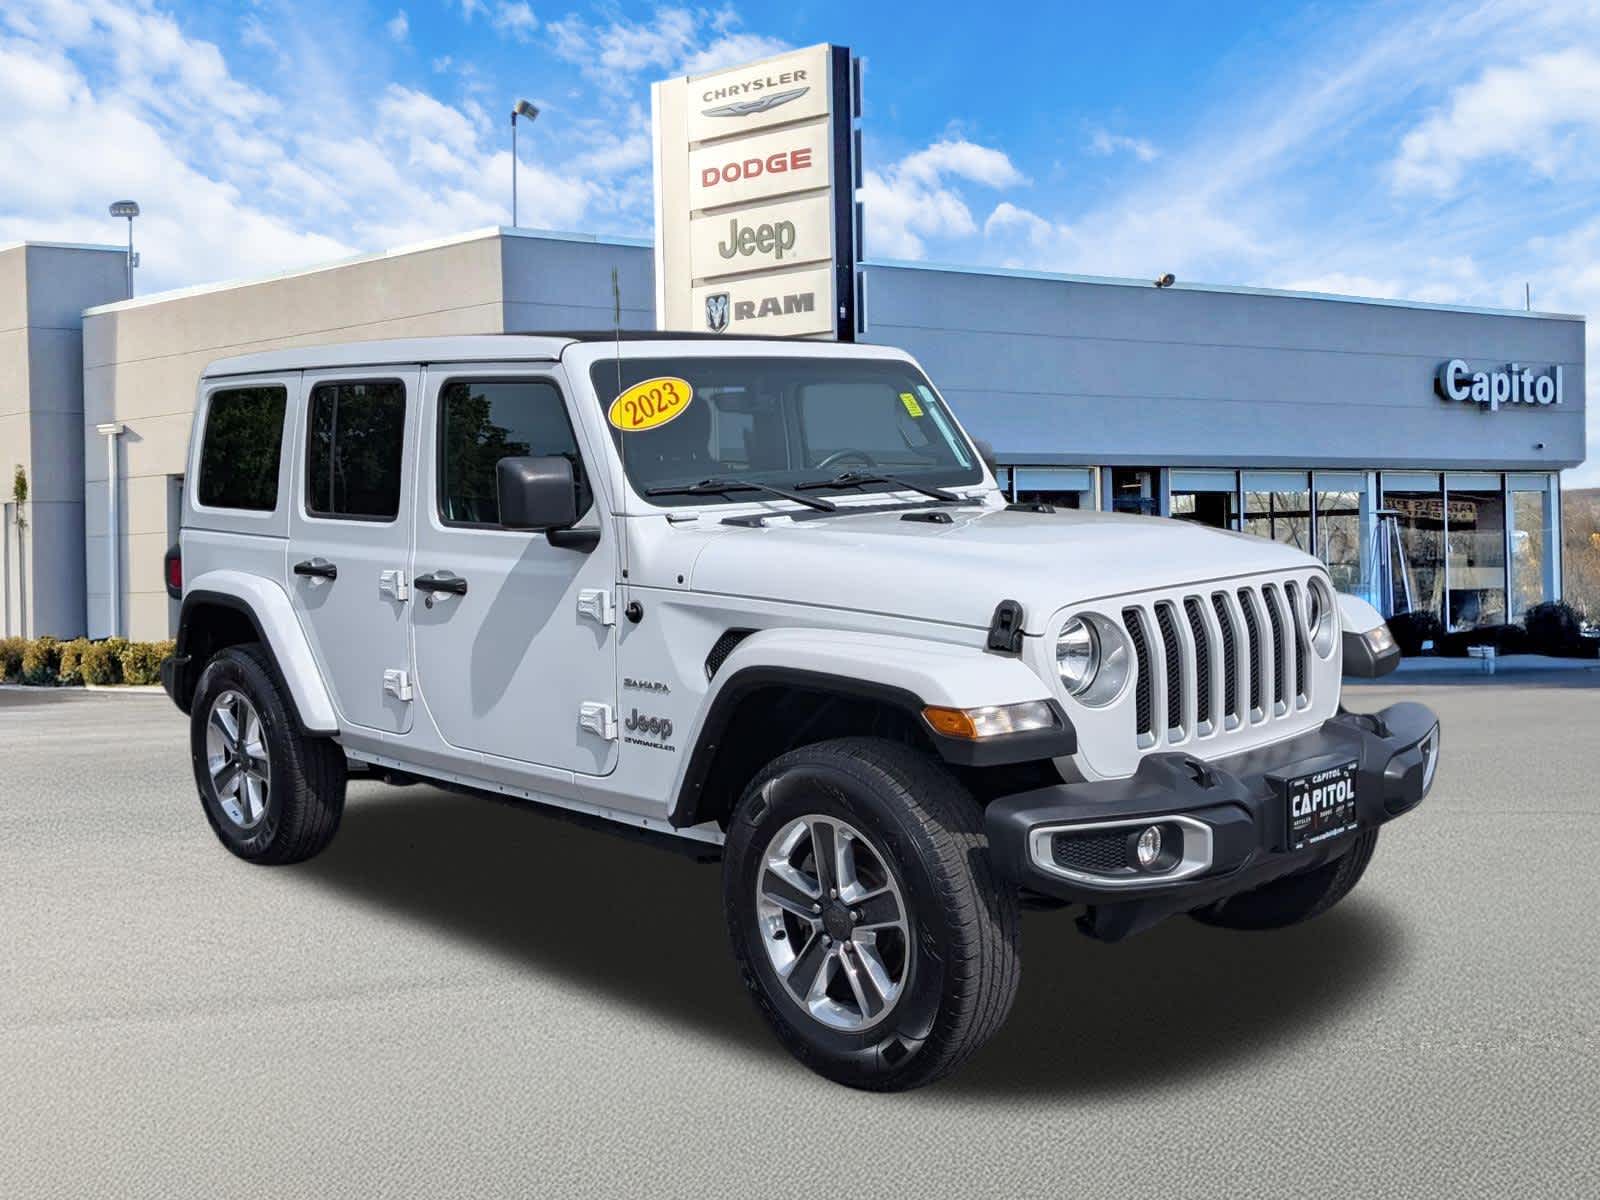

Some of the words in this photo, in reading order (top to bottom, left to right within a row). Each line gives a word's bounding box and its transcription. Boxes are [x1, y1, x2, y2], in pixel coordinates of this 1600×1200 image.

[702, 69, 808, 103] CHRYSLER
[702, 148, 812, 188] DODGE
[718, 218, 796, 260] Jeep
[734, 292, 815, 321] RAM
[1445, 359, 1563, 412] Capitol
[624, 382, 680, 426] 2023
[623, 678, 671, 694] SAHARA
[625, 708, 673, 741] Jeep
[632, 738, 676, 753] WRANGLER
[1312, 768, 1342, 784] CAPITOL
[1292, 778, 1355, 818] CAPITOL
